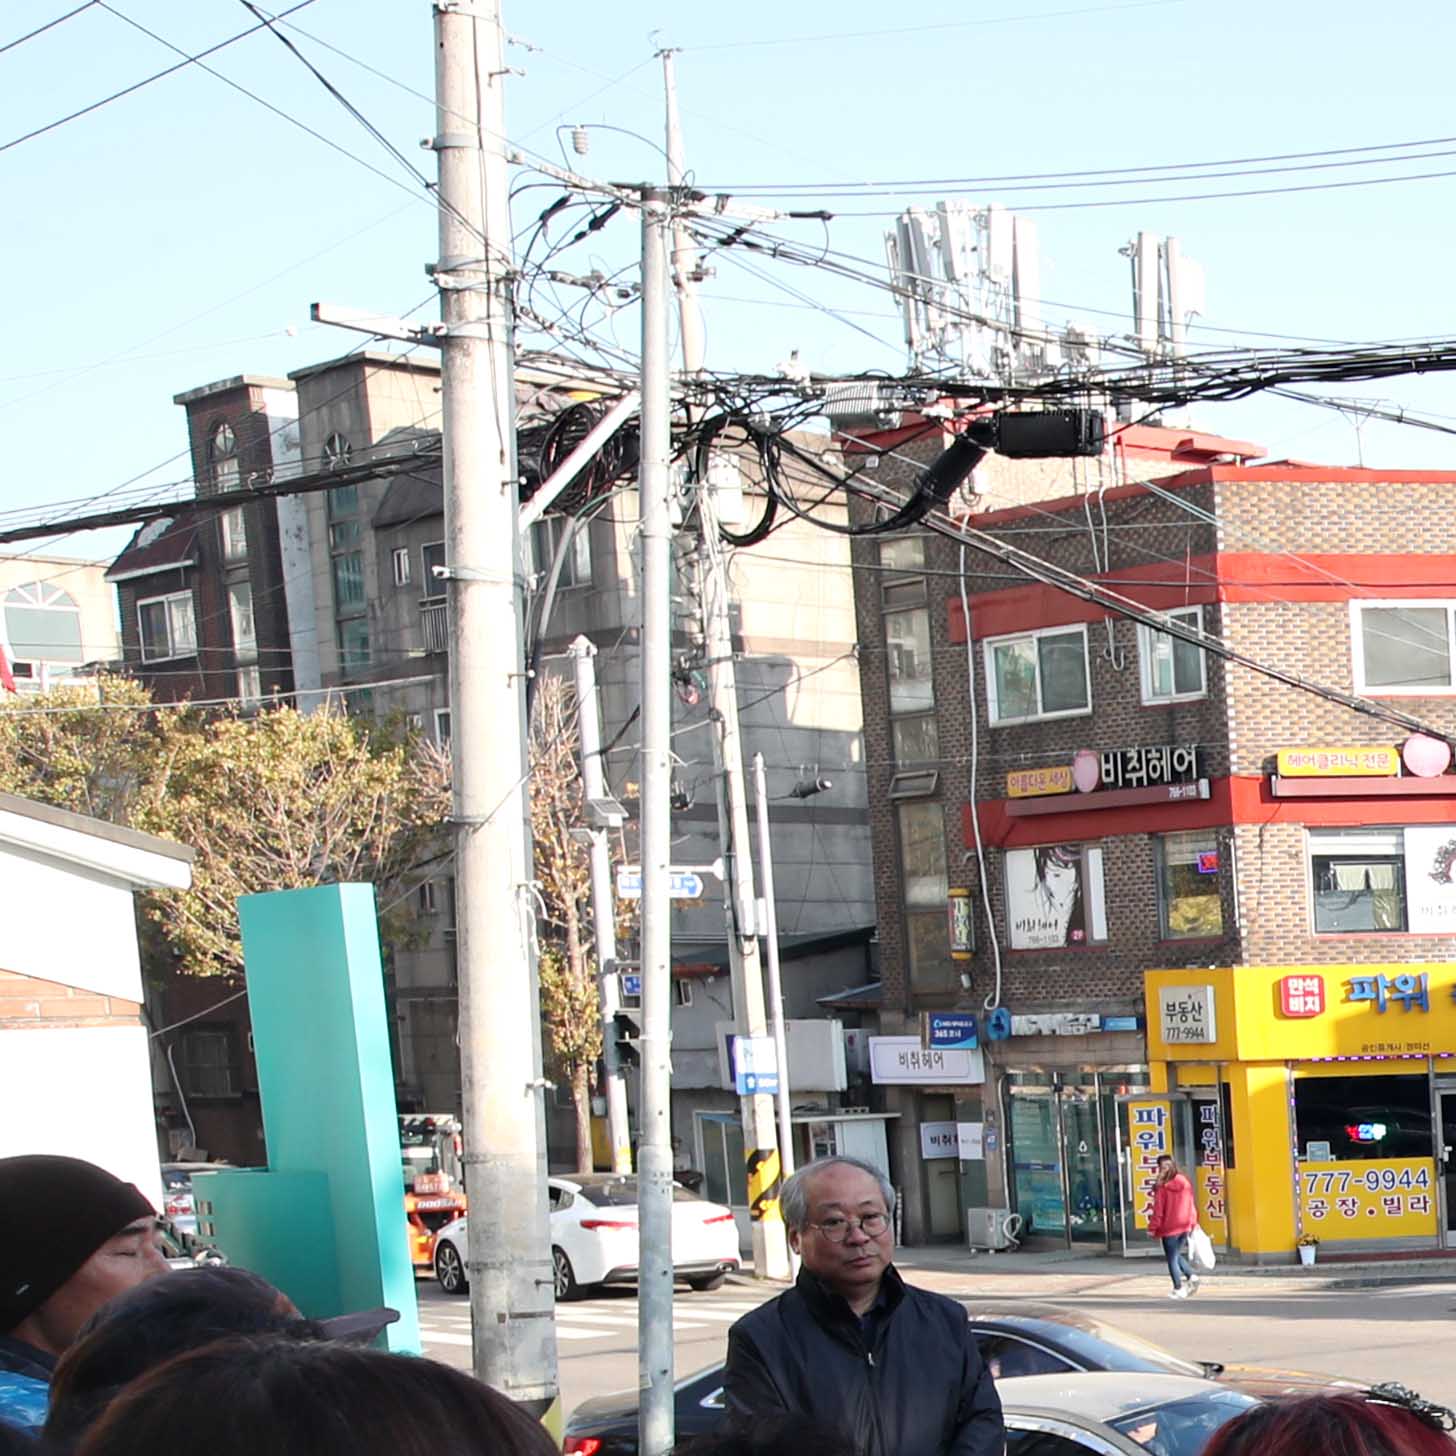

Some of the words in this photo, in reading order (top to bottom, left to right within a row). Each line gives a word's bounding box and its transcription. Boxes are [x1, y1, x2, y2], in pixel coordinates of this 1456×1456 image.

[1101, 745, 1198, 787] 비취헤어
[1287, 752, 1358, 770] 헤어클리닉
[1362, 751, 1391, 769] 전문
[1288, 977, 1320, 995] 만석
[1346, 972, 1430, 1013] 파워
[1165, 1001, 1203, 1023] 부동산
[1165, 1026, 1205, 1040] 777-9944
[898, 1050, 945, 1070] 비취헤어
[1305, 1167, 1430, 1195] 777-9944
